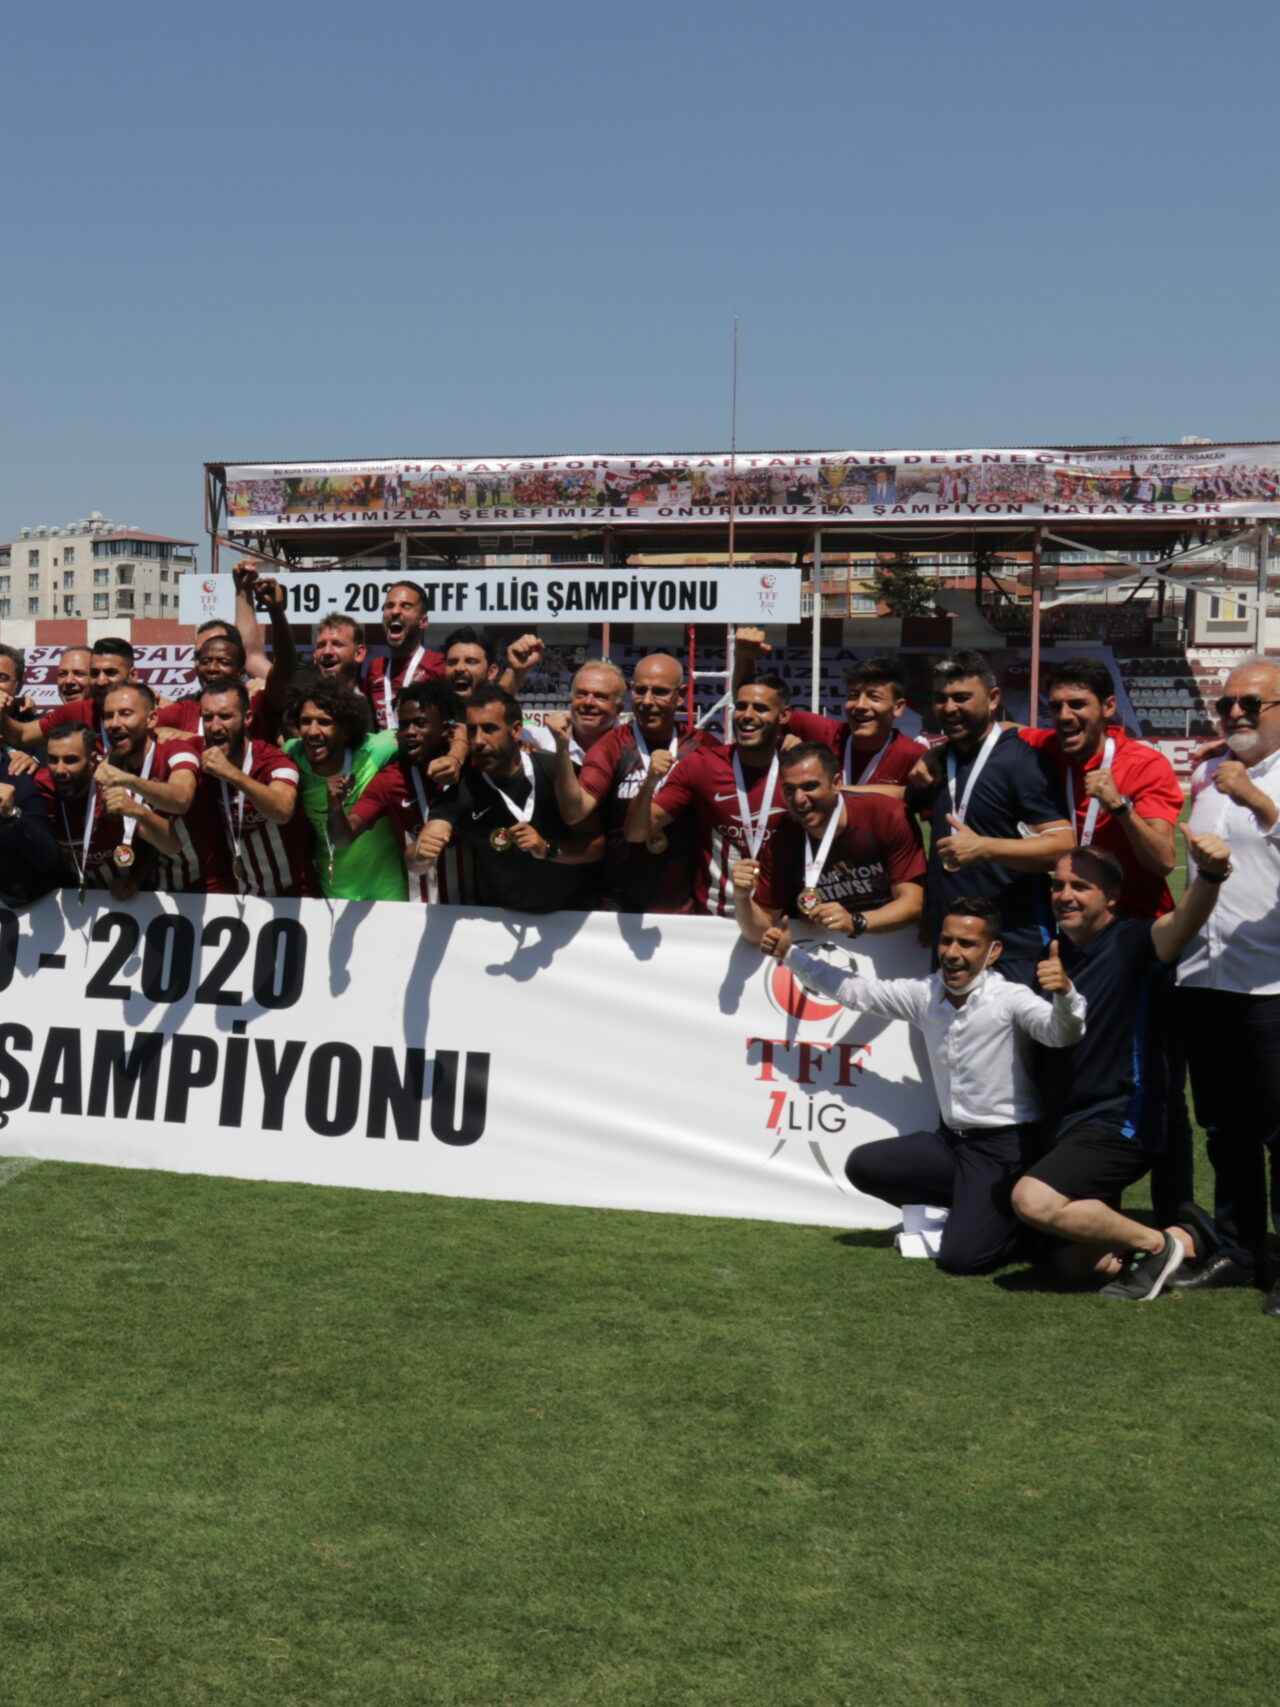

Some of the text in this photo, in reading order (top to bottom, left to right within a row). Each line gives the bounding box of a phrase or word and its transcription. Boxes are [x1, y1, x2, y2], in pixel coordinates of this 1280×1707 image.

[404, 453, 1070, 473] HATAYSPOR TARAFTARLAR DERNEĞİ
[277, 502, 1221, 524] HAKKIMIZLA ŞEREFİMİZLE ONURUMUZLA ŞAMPİYON HATAYSPOR
[475, 576, 539, 612] 1.LİG
[546, 575, 719, 618] ŞAMPİYONU
[38, 953, 67, 970] -
[86, 911, 310, 1010] 2020
[746, 1037, 872, 1088] TFF
